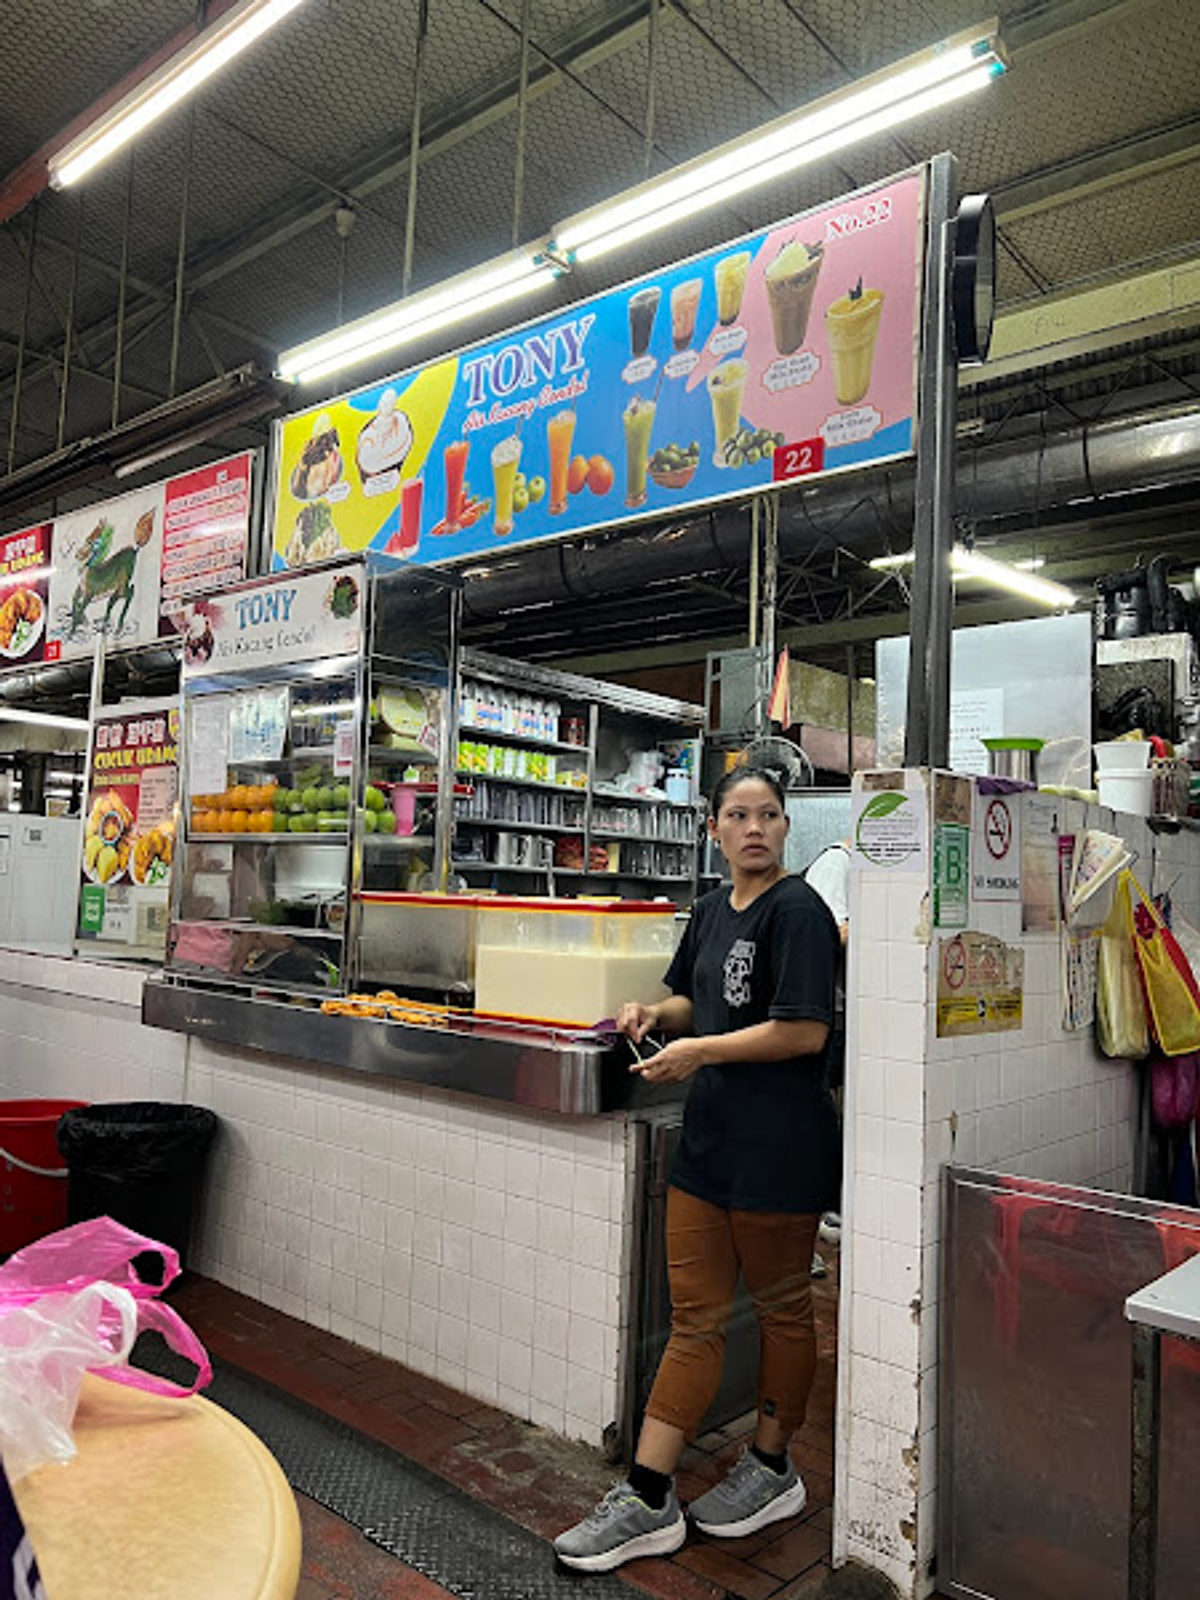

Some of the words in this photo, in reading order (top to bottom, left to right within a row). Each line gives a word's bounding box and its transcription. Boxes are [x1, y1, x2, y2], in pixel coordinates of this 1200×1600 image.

[825, 197, 891, 240] No.22
[462, 313, 596, 407] TONY
[784, 447, 813, 473] 22
[235, 589, 298, 630] TONY
[946, 846, 961, 884] B
